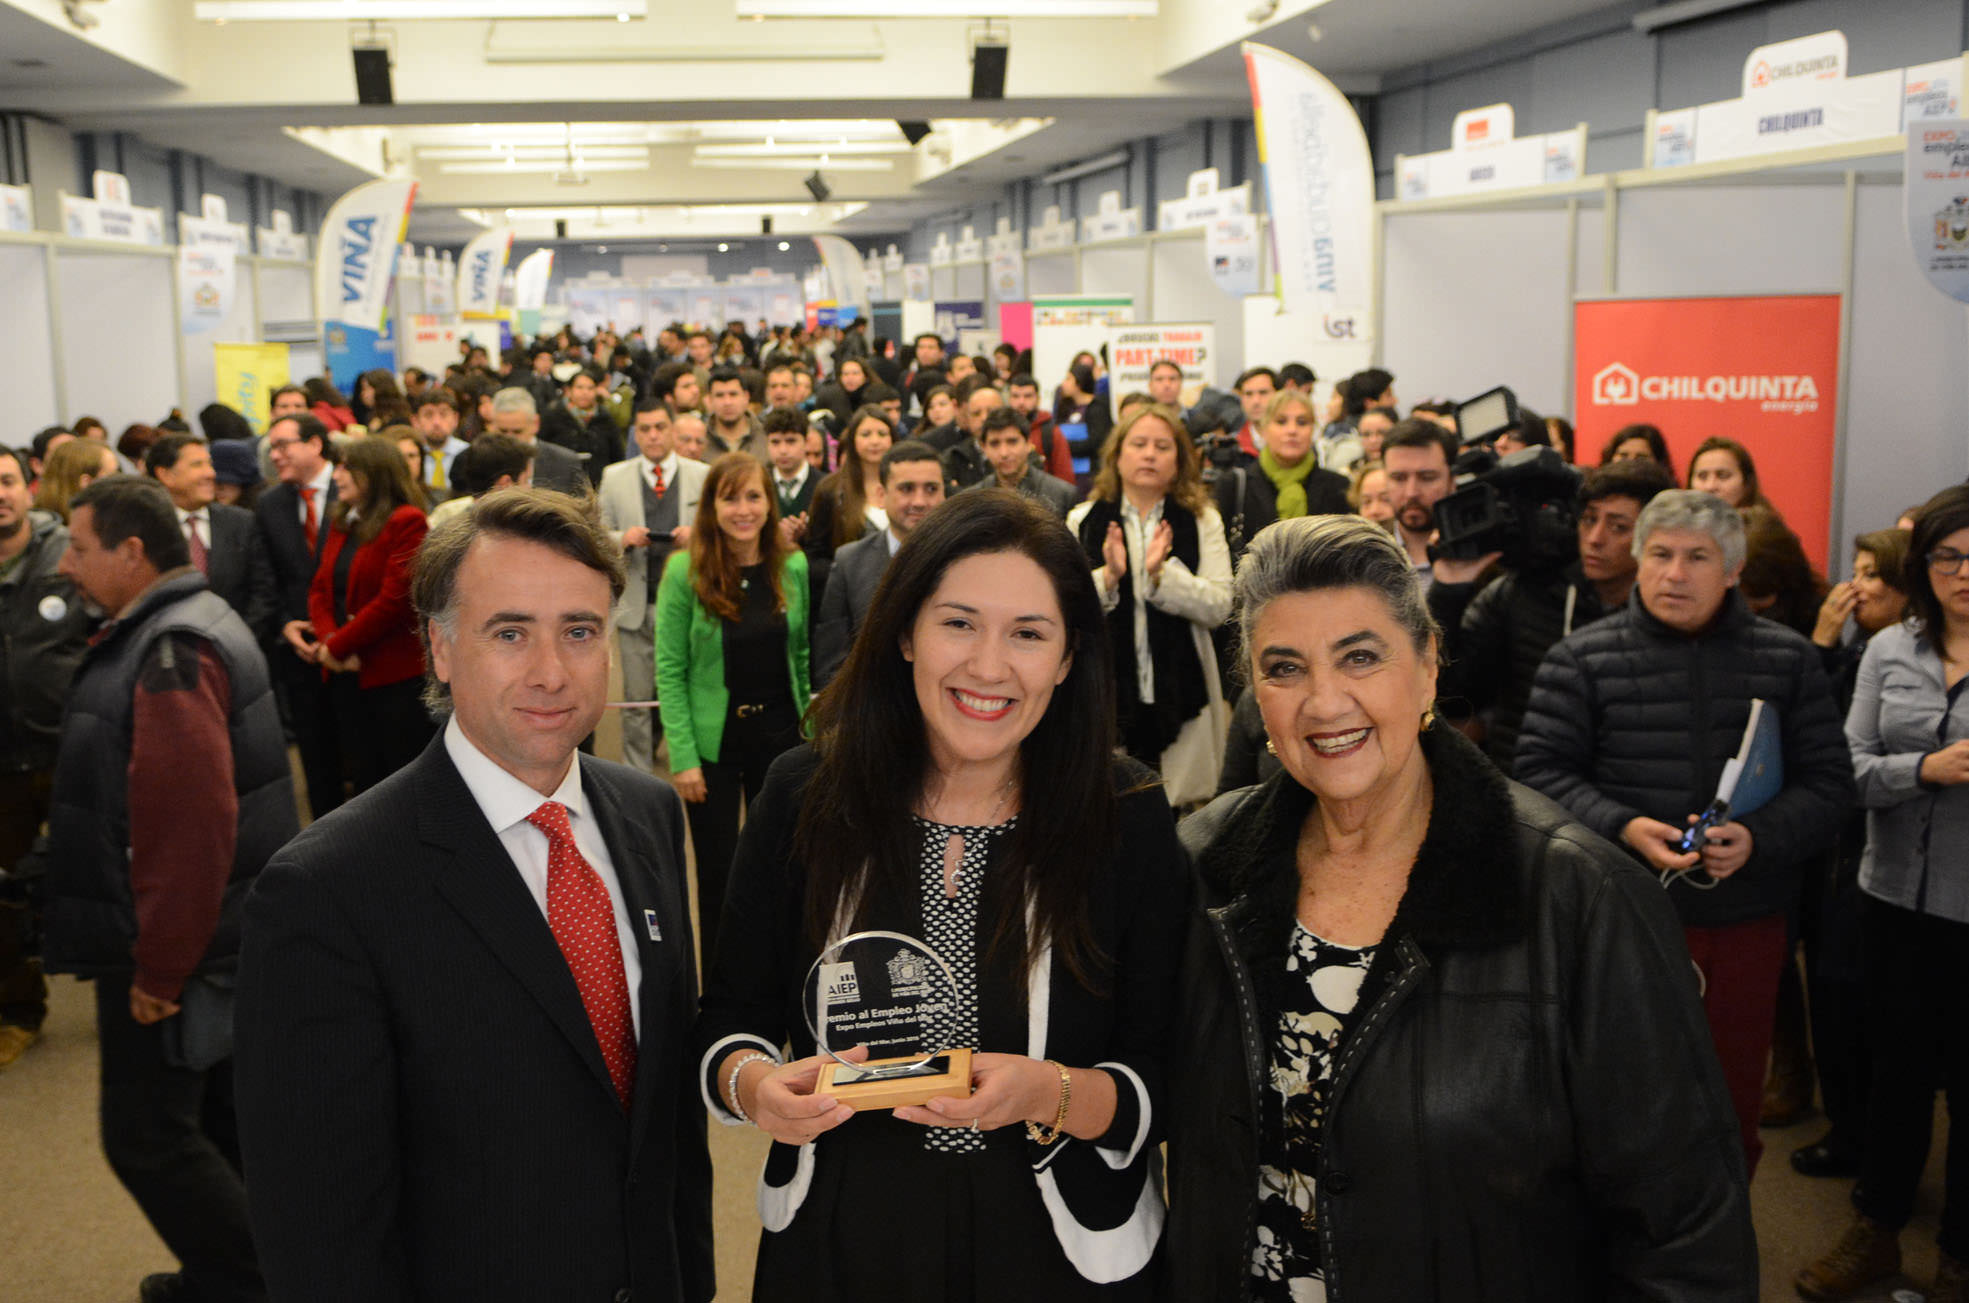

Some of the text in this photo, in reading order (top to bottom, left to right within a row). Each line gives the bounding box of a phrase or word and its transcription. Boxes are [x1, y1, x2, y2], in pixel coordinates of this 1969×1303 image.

[1771, 55, 1838, 80] CHILQUINTA
[1758, 107, 1823, 135] CHILQUINTA
[340, 216, 377, 303] VIÑA
[1641, 375, 1819, 402] CHILQUINTA
[828, 983, 857, 995] AIEP
[836, 1023, 855, 1032] Expo
[856, 1020, 886, 1029] Empleos
[905, 1015, 917, 1024] del
[858, 1009, 869, 1019] al
[871, 1005, 913, 1019] Empleo
